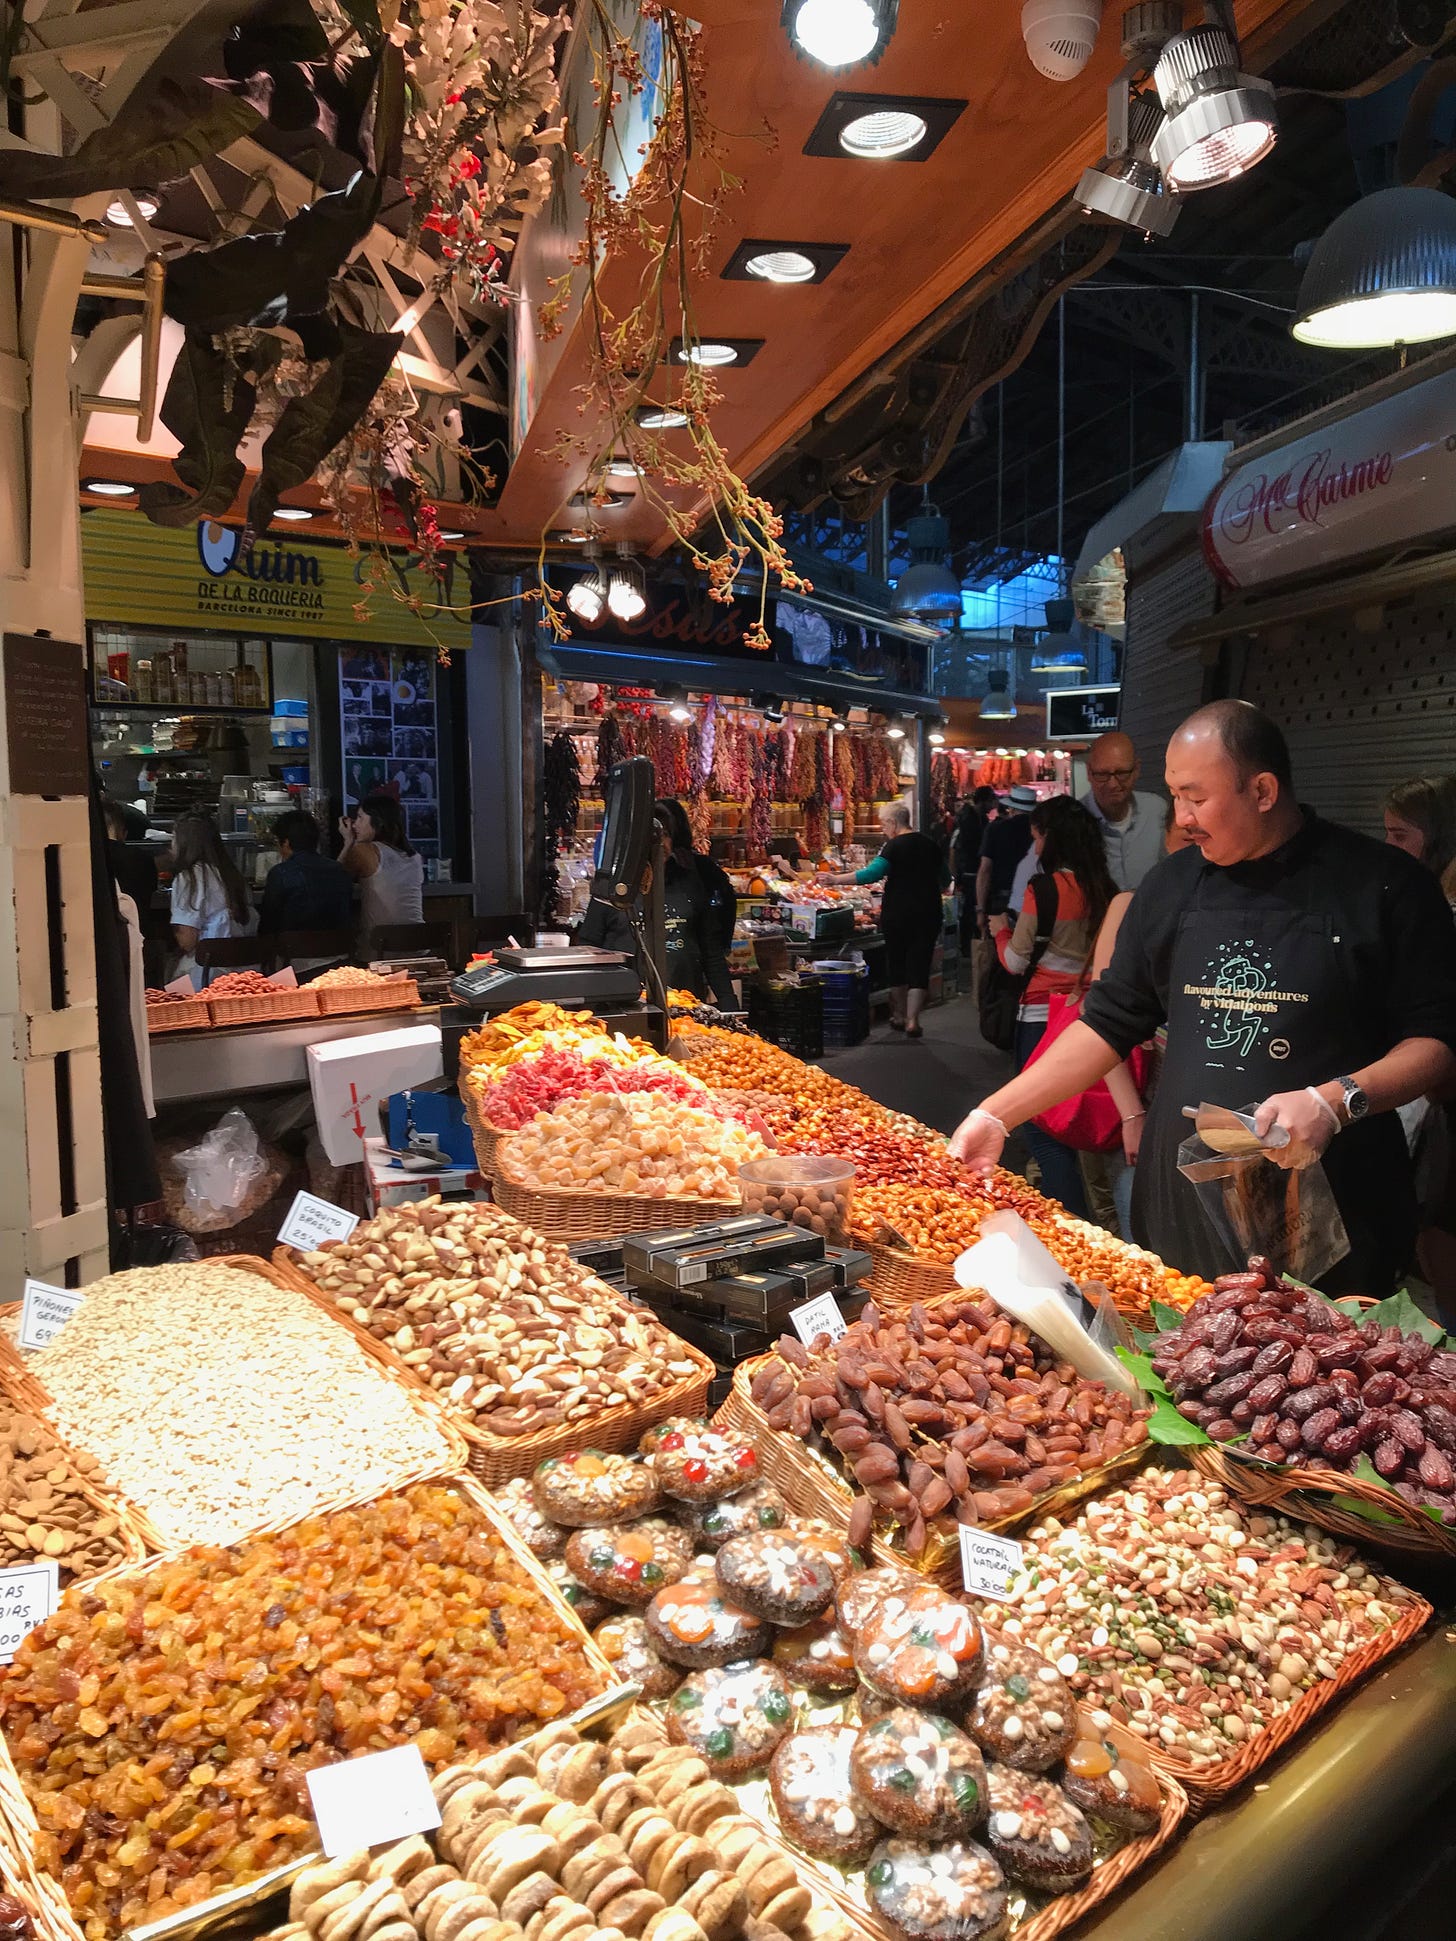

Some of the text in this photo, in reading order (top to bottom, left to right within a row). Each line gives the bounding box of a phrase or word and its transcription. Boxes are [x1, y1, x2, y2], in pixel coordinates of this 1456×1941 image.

[197, 519, 325, 587] Quim
[198, 582, 325, 609] DE LA BOQUERIA
[198, 602, 263, 614] BARCELONA
[266, 607, 297, 618] SINCE
[1082, 704, 1095, 716] La
[1183, 984, 1309, 1003] flavoured adventures
[1200, 998, 1213, 1009] by
[298, 1213, 333, 1235] BRASIL
[303, 1205, 342, 1227] COQUITO
